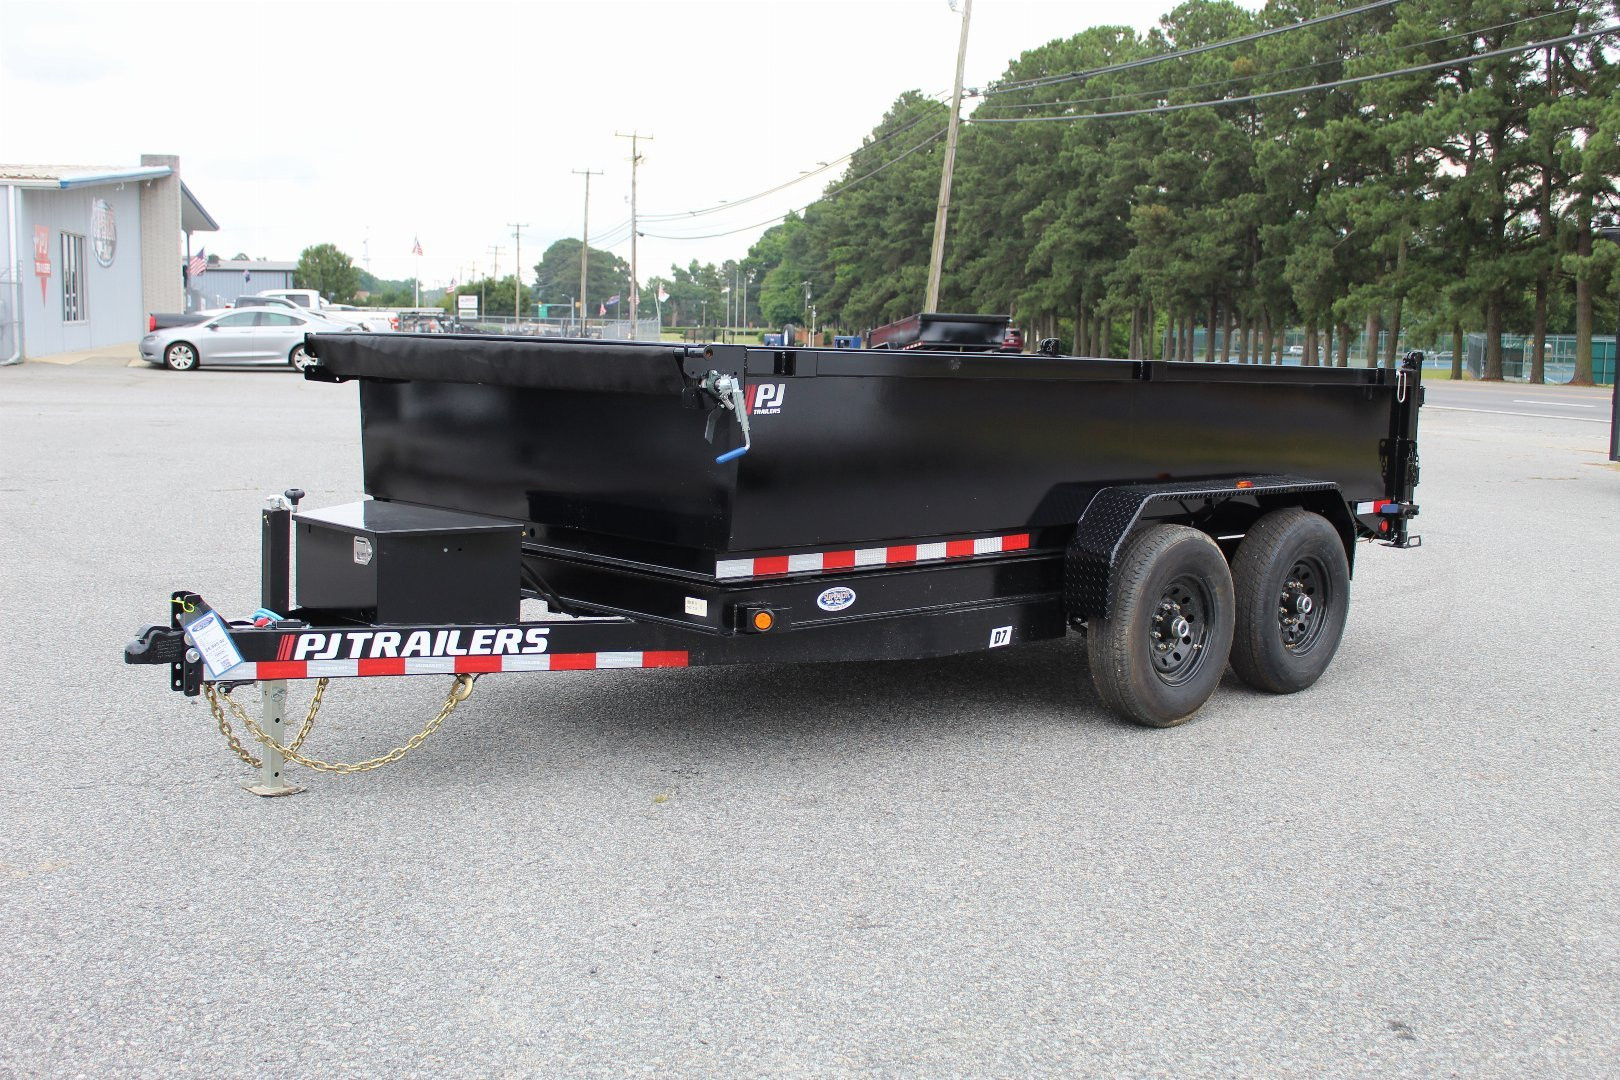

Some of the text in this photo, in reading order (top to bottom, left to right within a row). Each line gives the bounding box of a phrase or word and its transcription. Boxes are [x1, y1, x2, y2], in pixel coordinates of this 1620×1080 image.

[755, 384, 786, 408] PJ
[293, 628, 551, 661] PJ TRAILERS
